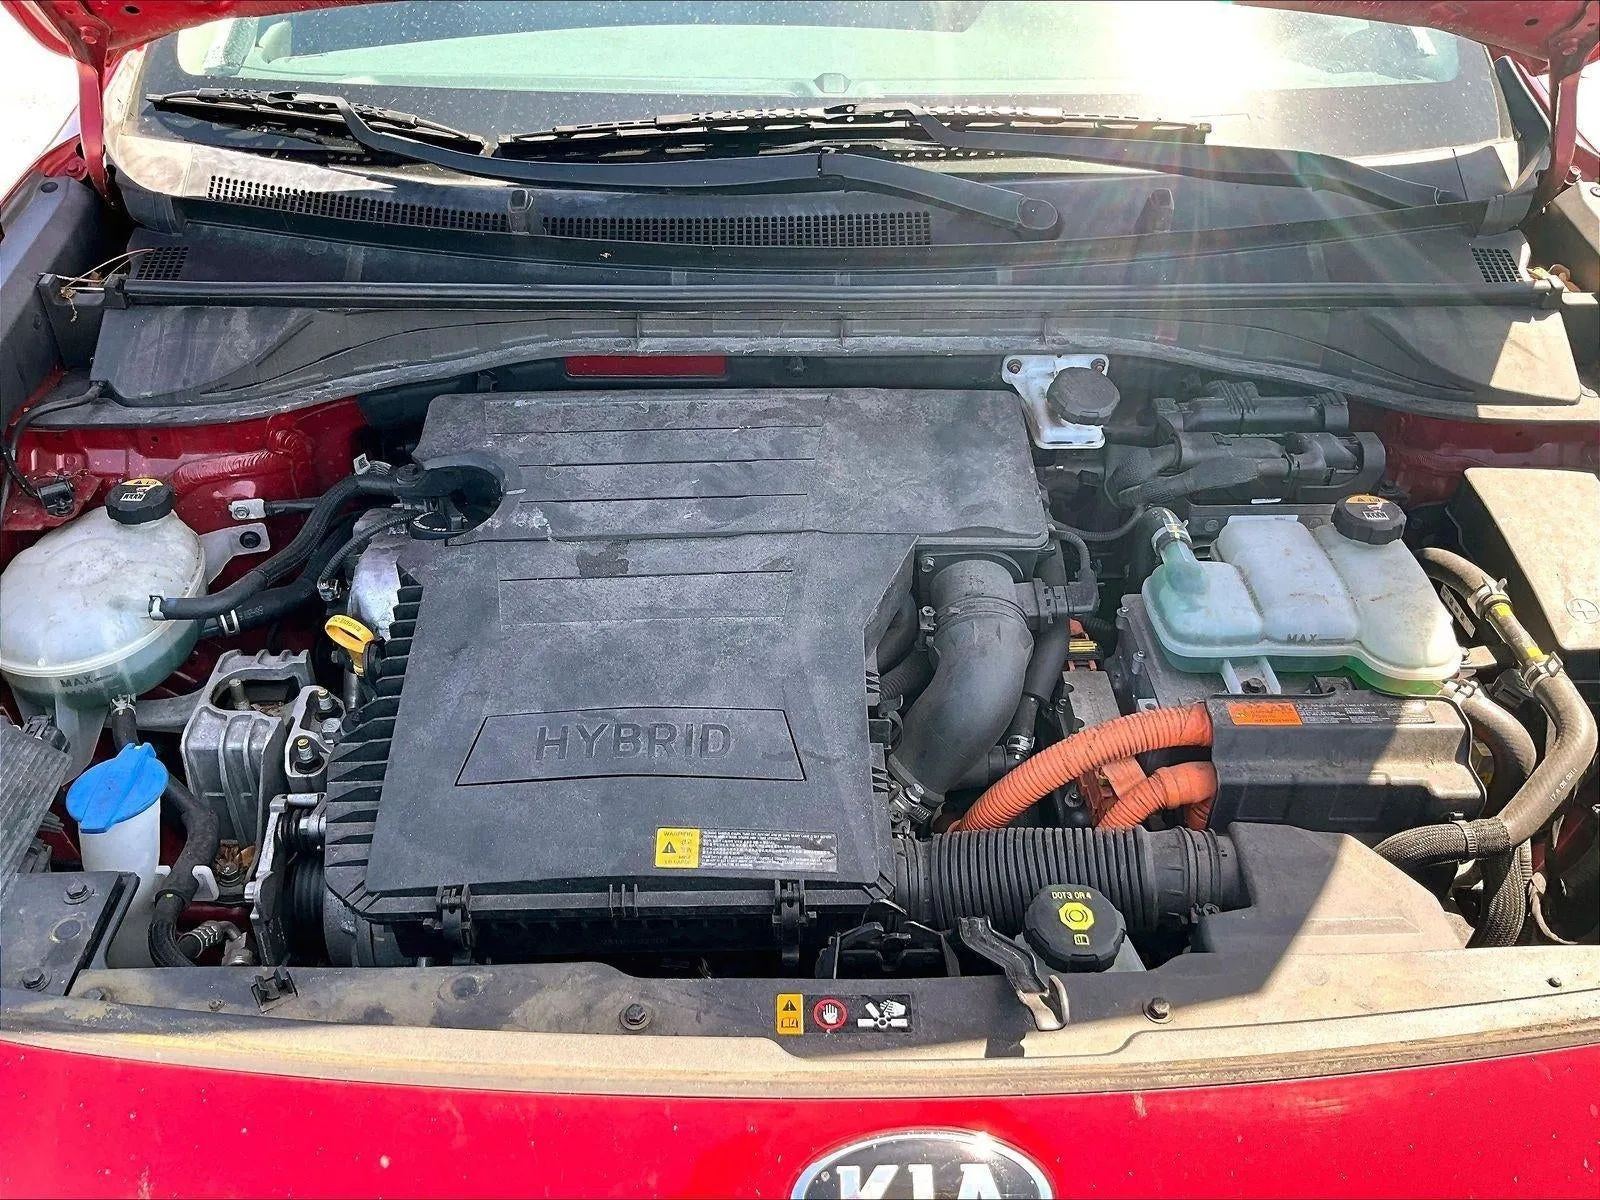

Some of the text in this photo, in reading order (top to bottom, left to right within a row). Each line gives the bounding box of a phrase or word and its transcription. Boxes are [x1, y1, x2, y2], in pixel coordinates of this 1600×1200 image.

[1287, 633, 1318, 646] MAX
[59, 675, 94, 688] MAX
[535, 721, 734, 762] HYBRID
[1074, 891, 1085, 899] OR
[836, 1163, 1003, 1200] KIA
